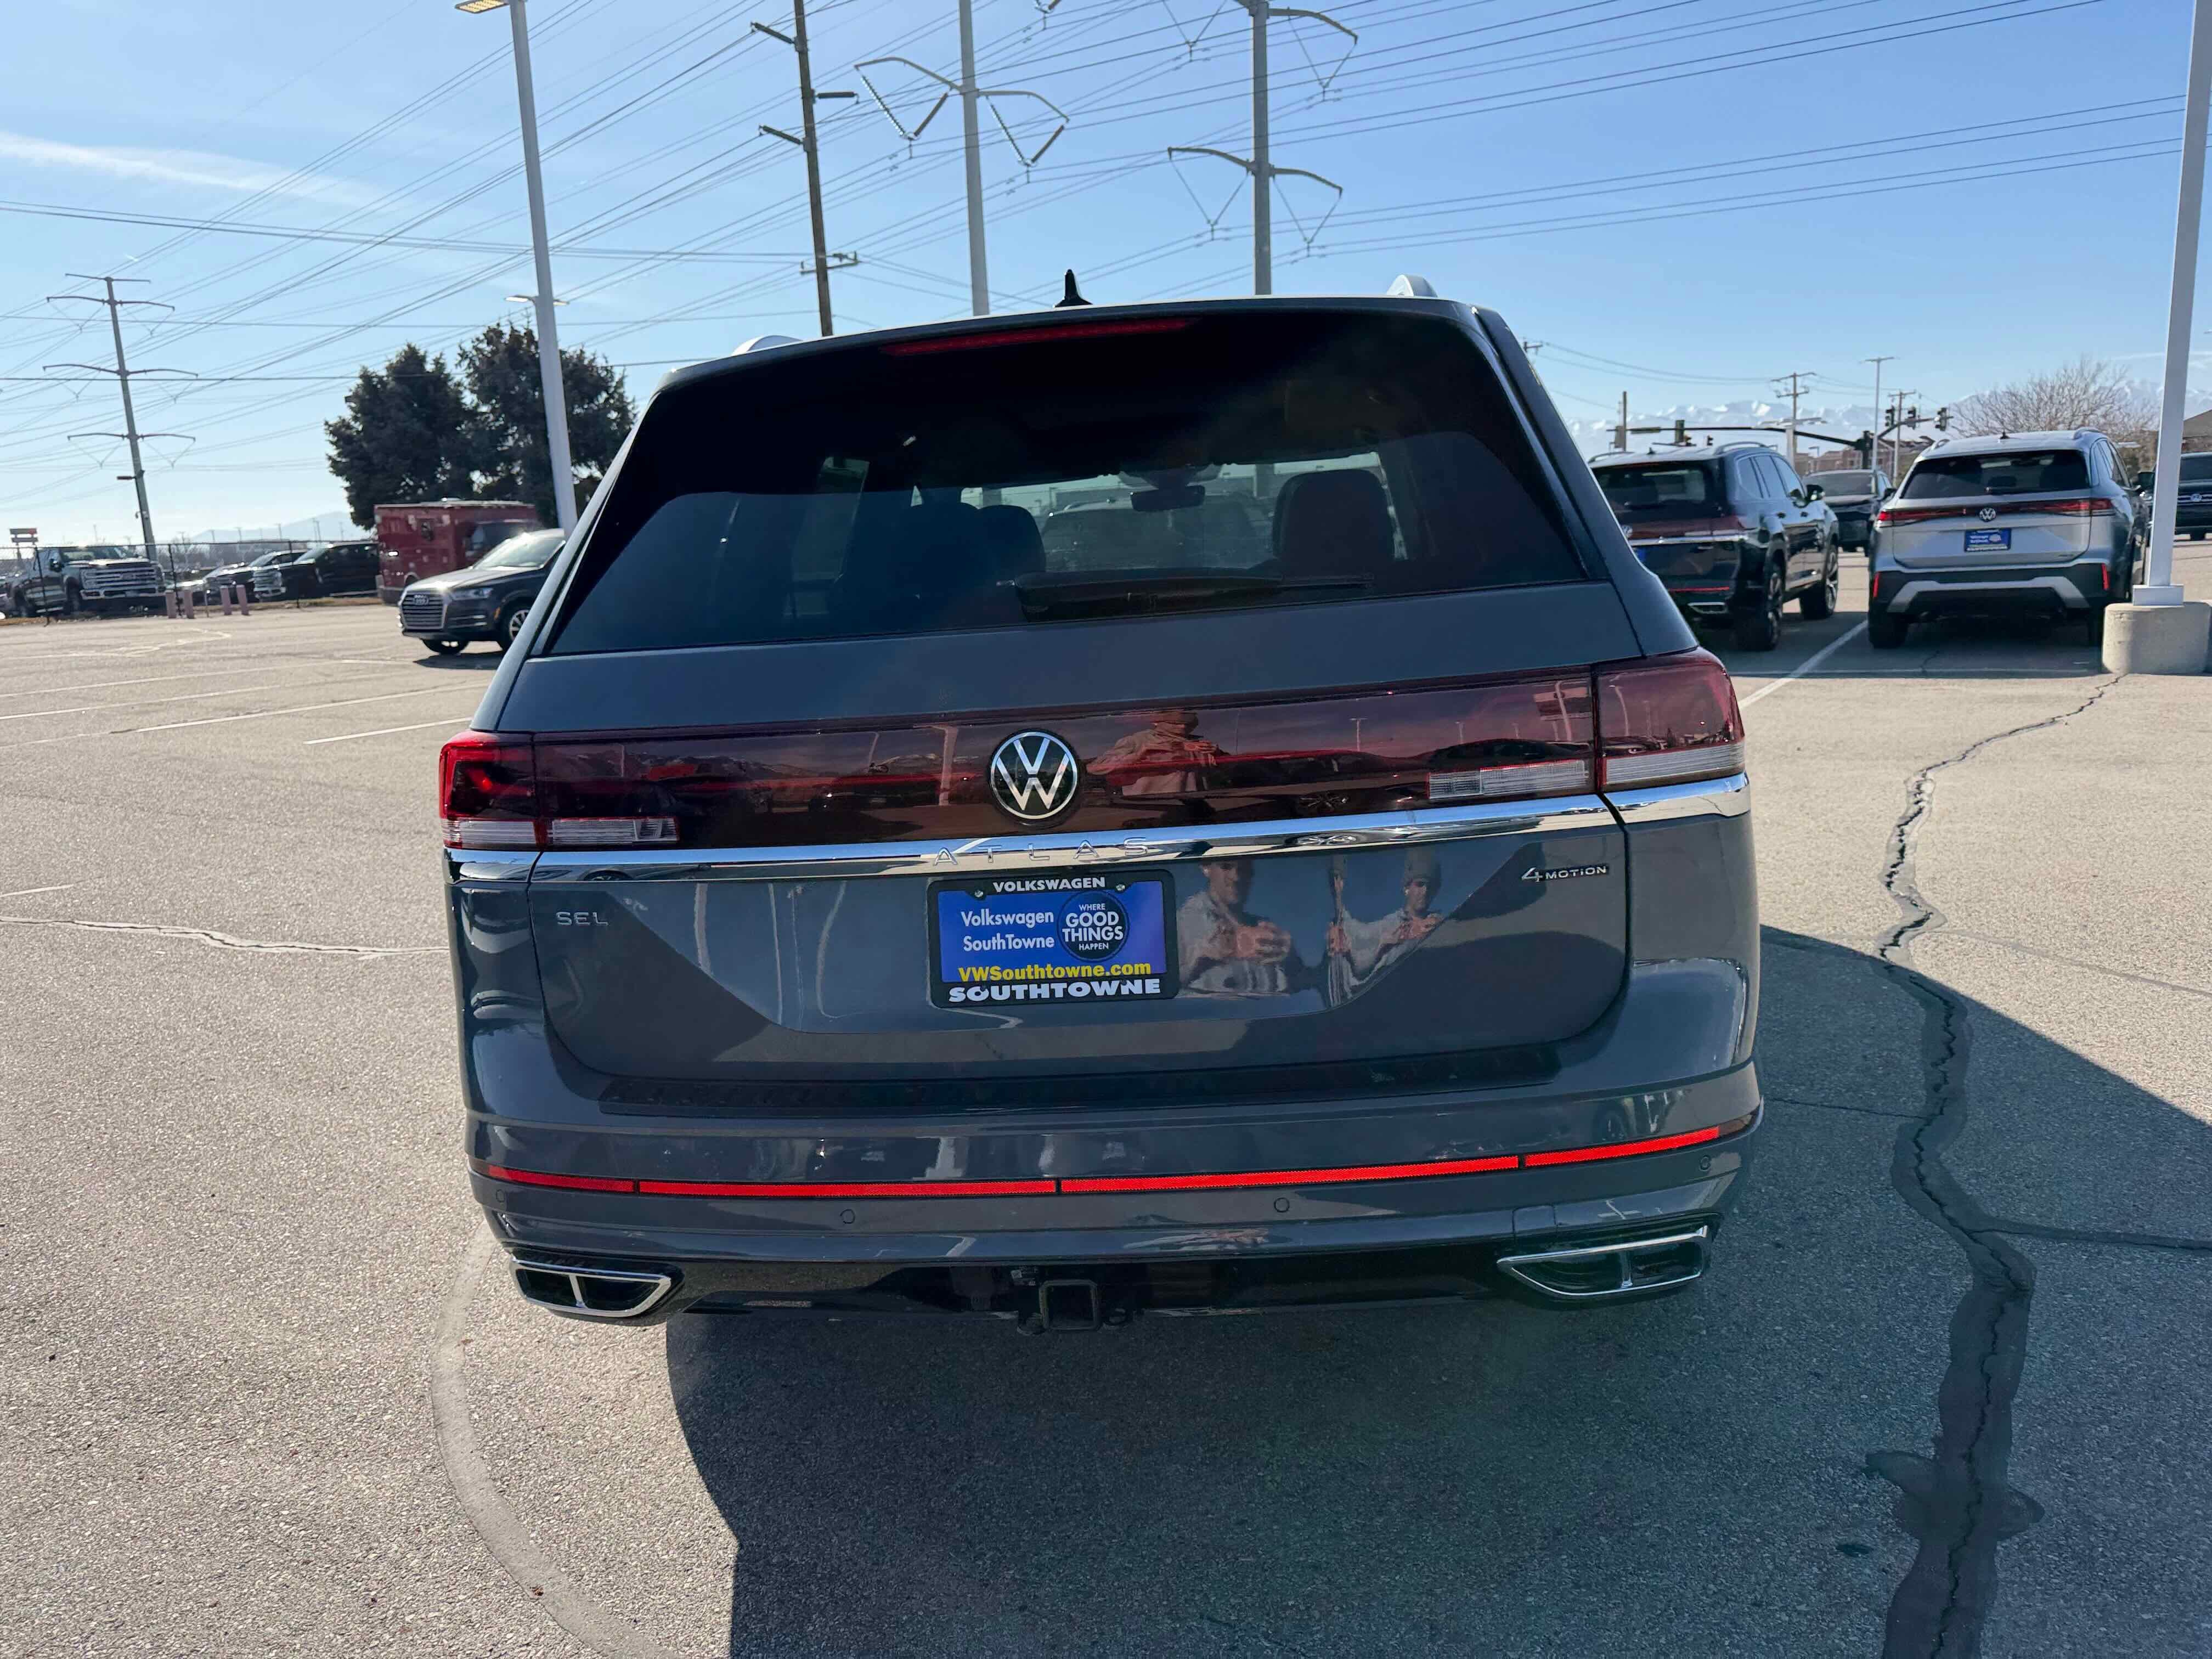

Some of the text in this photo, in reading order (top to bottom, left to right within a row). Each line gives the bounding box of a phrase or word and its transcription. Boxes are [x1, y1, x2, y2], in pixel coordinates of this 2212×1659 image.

[994, 735, 1072, 813] VW
[934, 837, 1148, 865] ATLAS
[1521, 866, 1607, 882] 4MOTION
[993, 877, 1105, 893] VOLKSWAGEN
[556, 911, 608, 926] SEL
[961, 909, 1054, 928] Volkswagen
[1065, 912, 1119, 927] GOOD
[1062, 926, 1124, 942] THINGS
[1079, 943, 1109, 951] HAPPEN
[958, 962, 1151, 981] VWSouthtowne.com
[949, 979, 1160, 1002] SOUTHTOWNE
